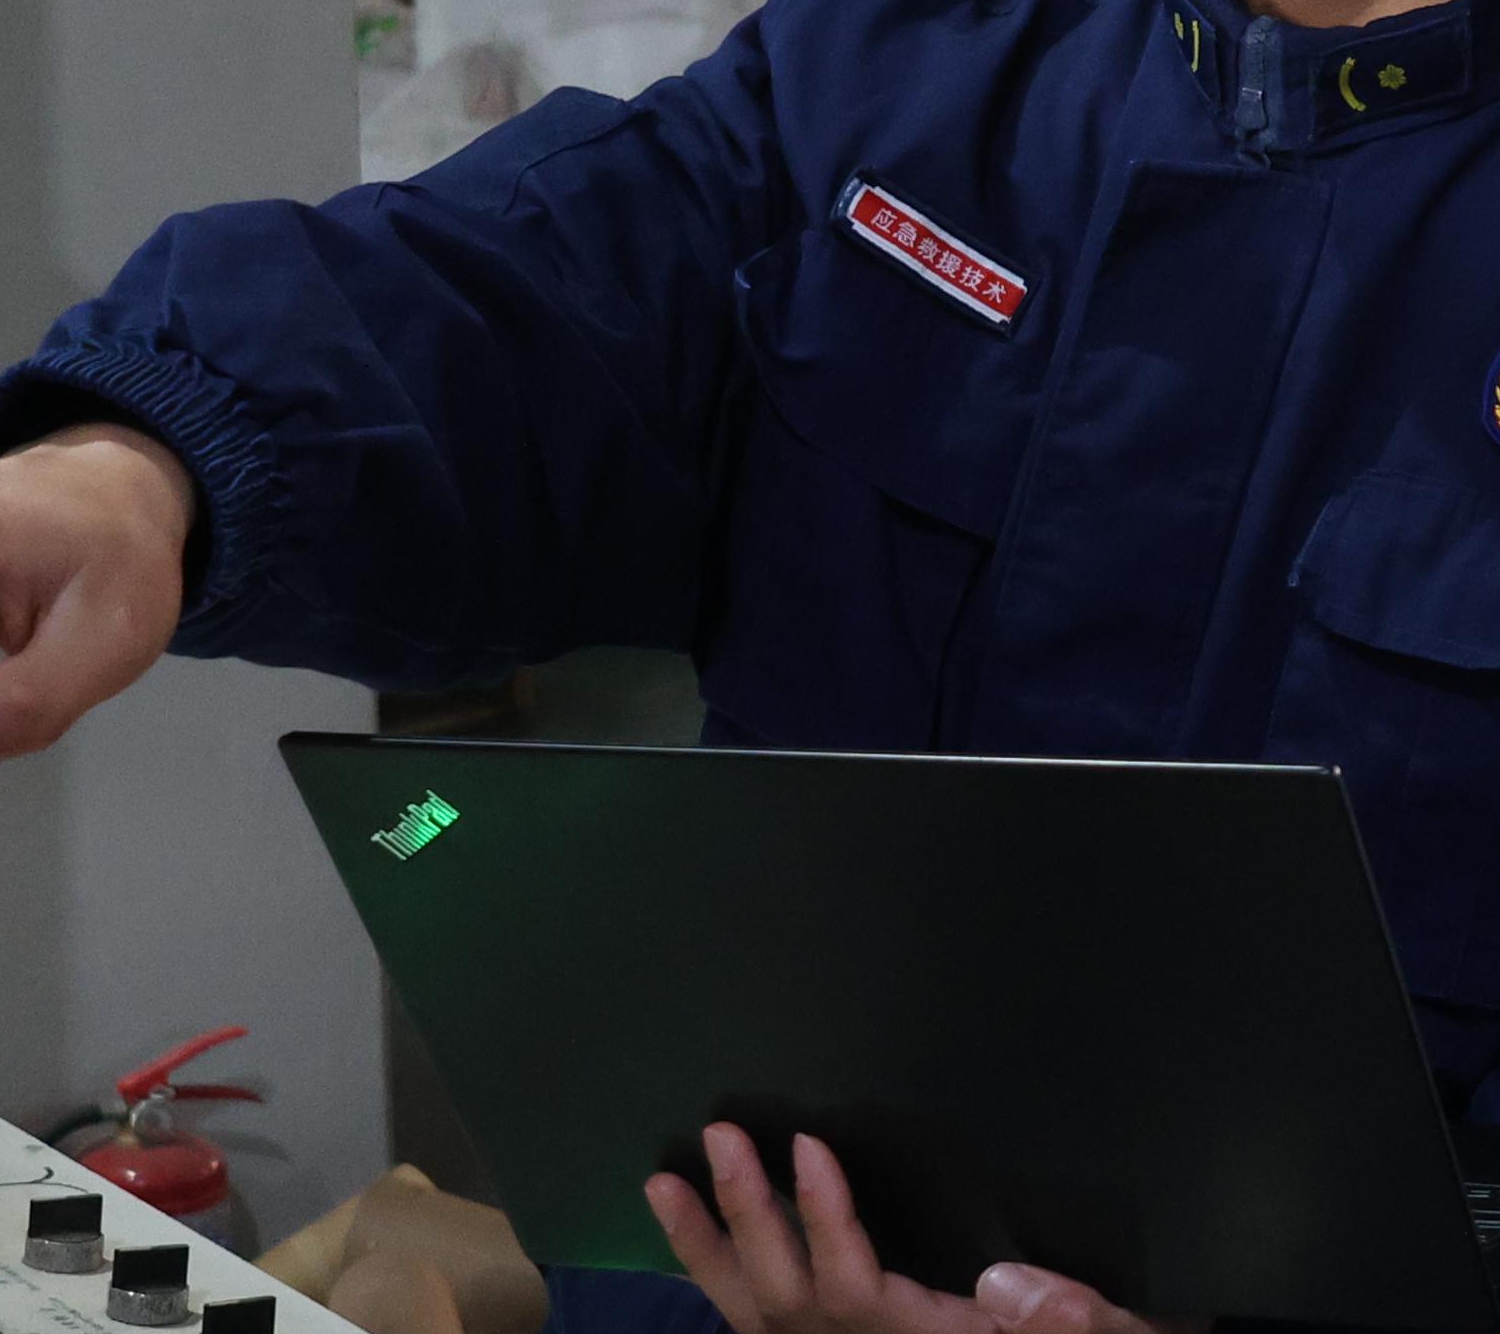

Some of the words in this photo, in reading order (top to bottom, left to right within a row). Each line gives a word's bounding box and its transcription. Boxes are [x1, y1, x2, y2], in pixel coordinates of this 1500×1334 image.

[870, 206, 1008, 304] 应急救援技术
[370, 789, 460, 860] ThinkPad
